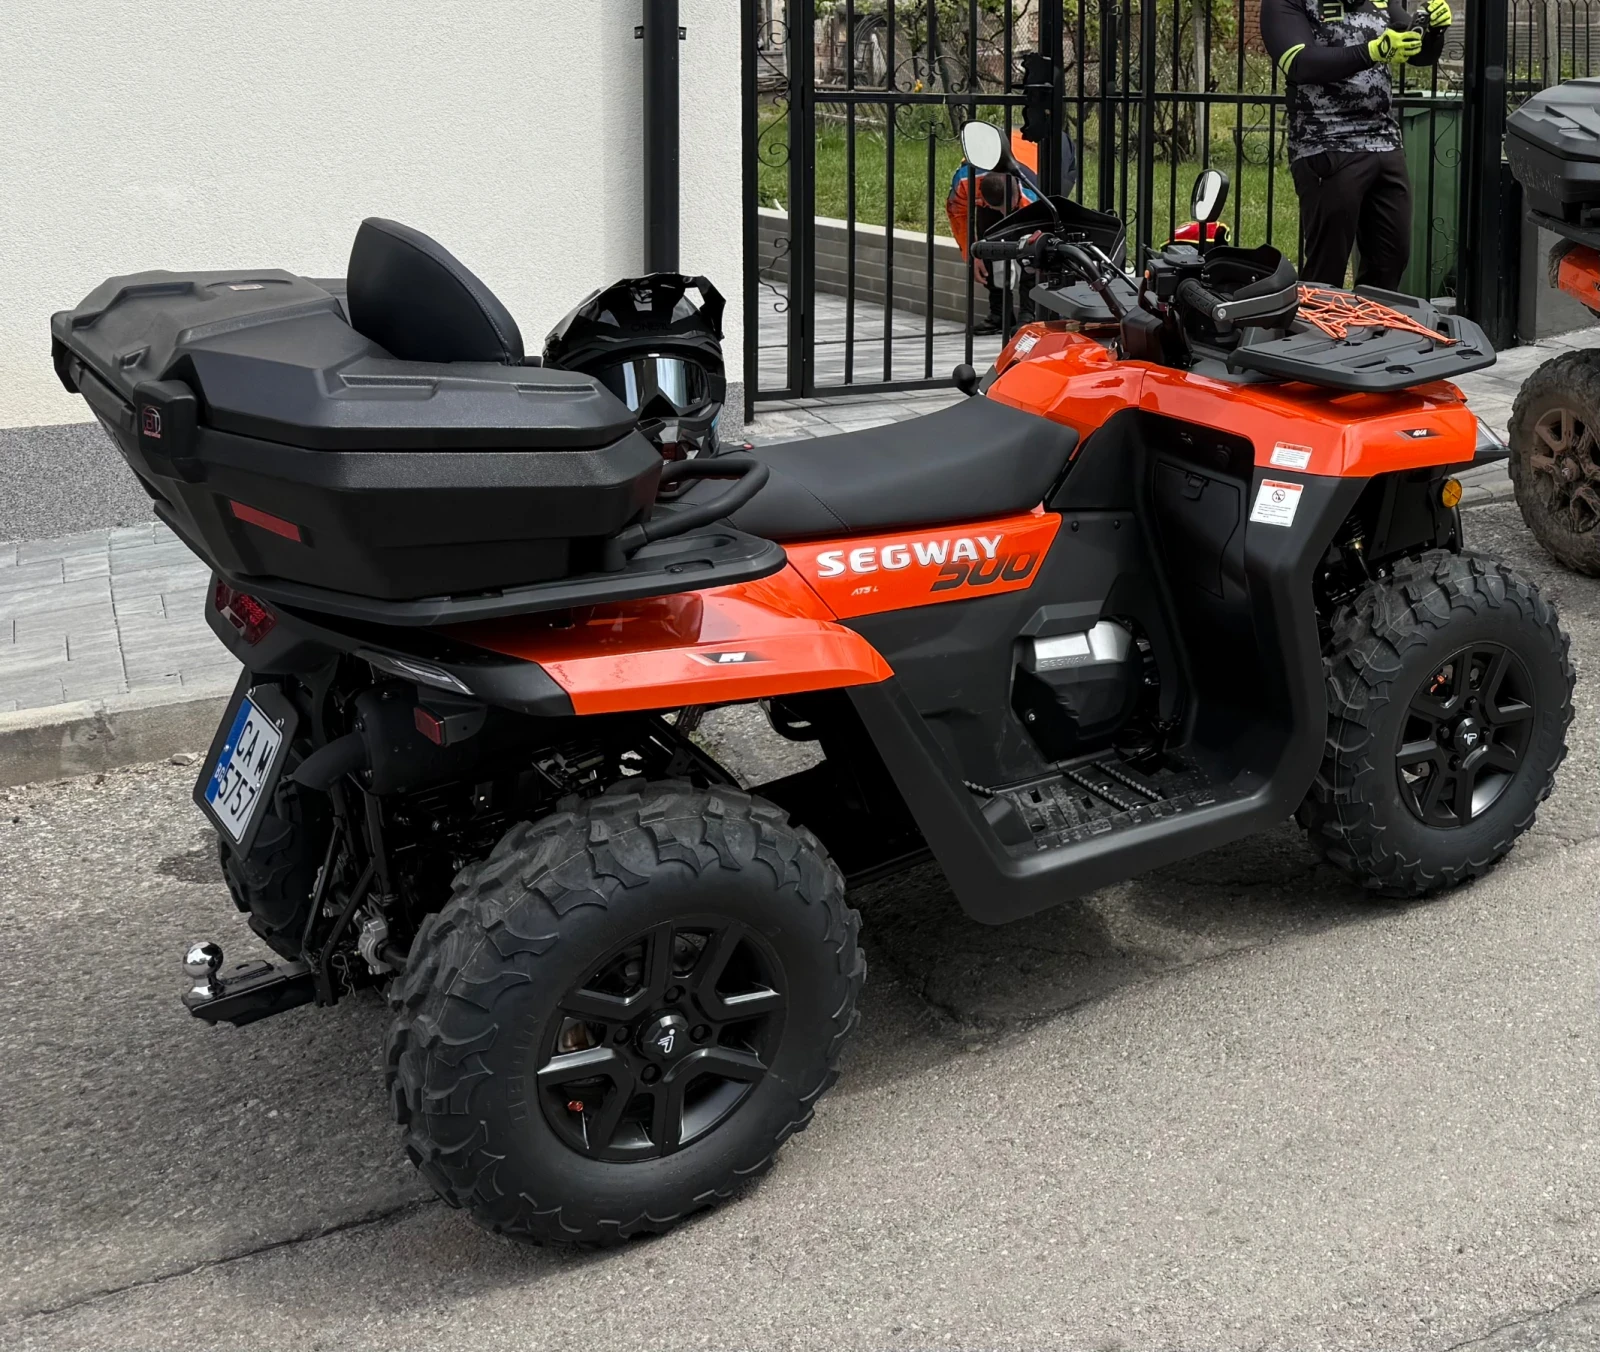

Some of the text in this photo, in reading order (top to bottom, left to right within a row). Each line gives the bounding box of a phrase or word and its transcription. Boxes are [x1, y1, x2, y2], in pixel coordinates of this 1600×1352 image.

[816, 534, 1004, 578] SEGWAY
[929, 551, 1041, 592] 500
[236, 720, 274, 781] CA M
[217, 763, 257, 822] 5757
